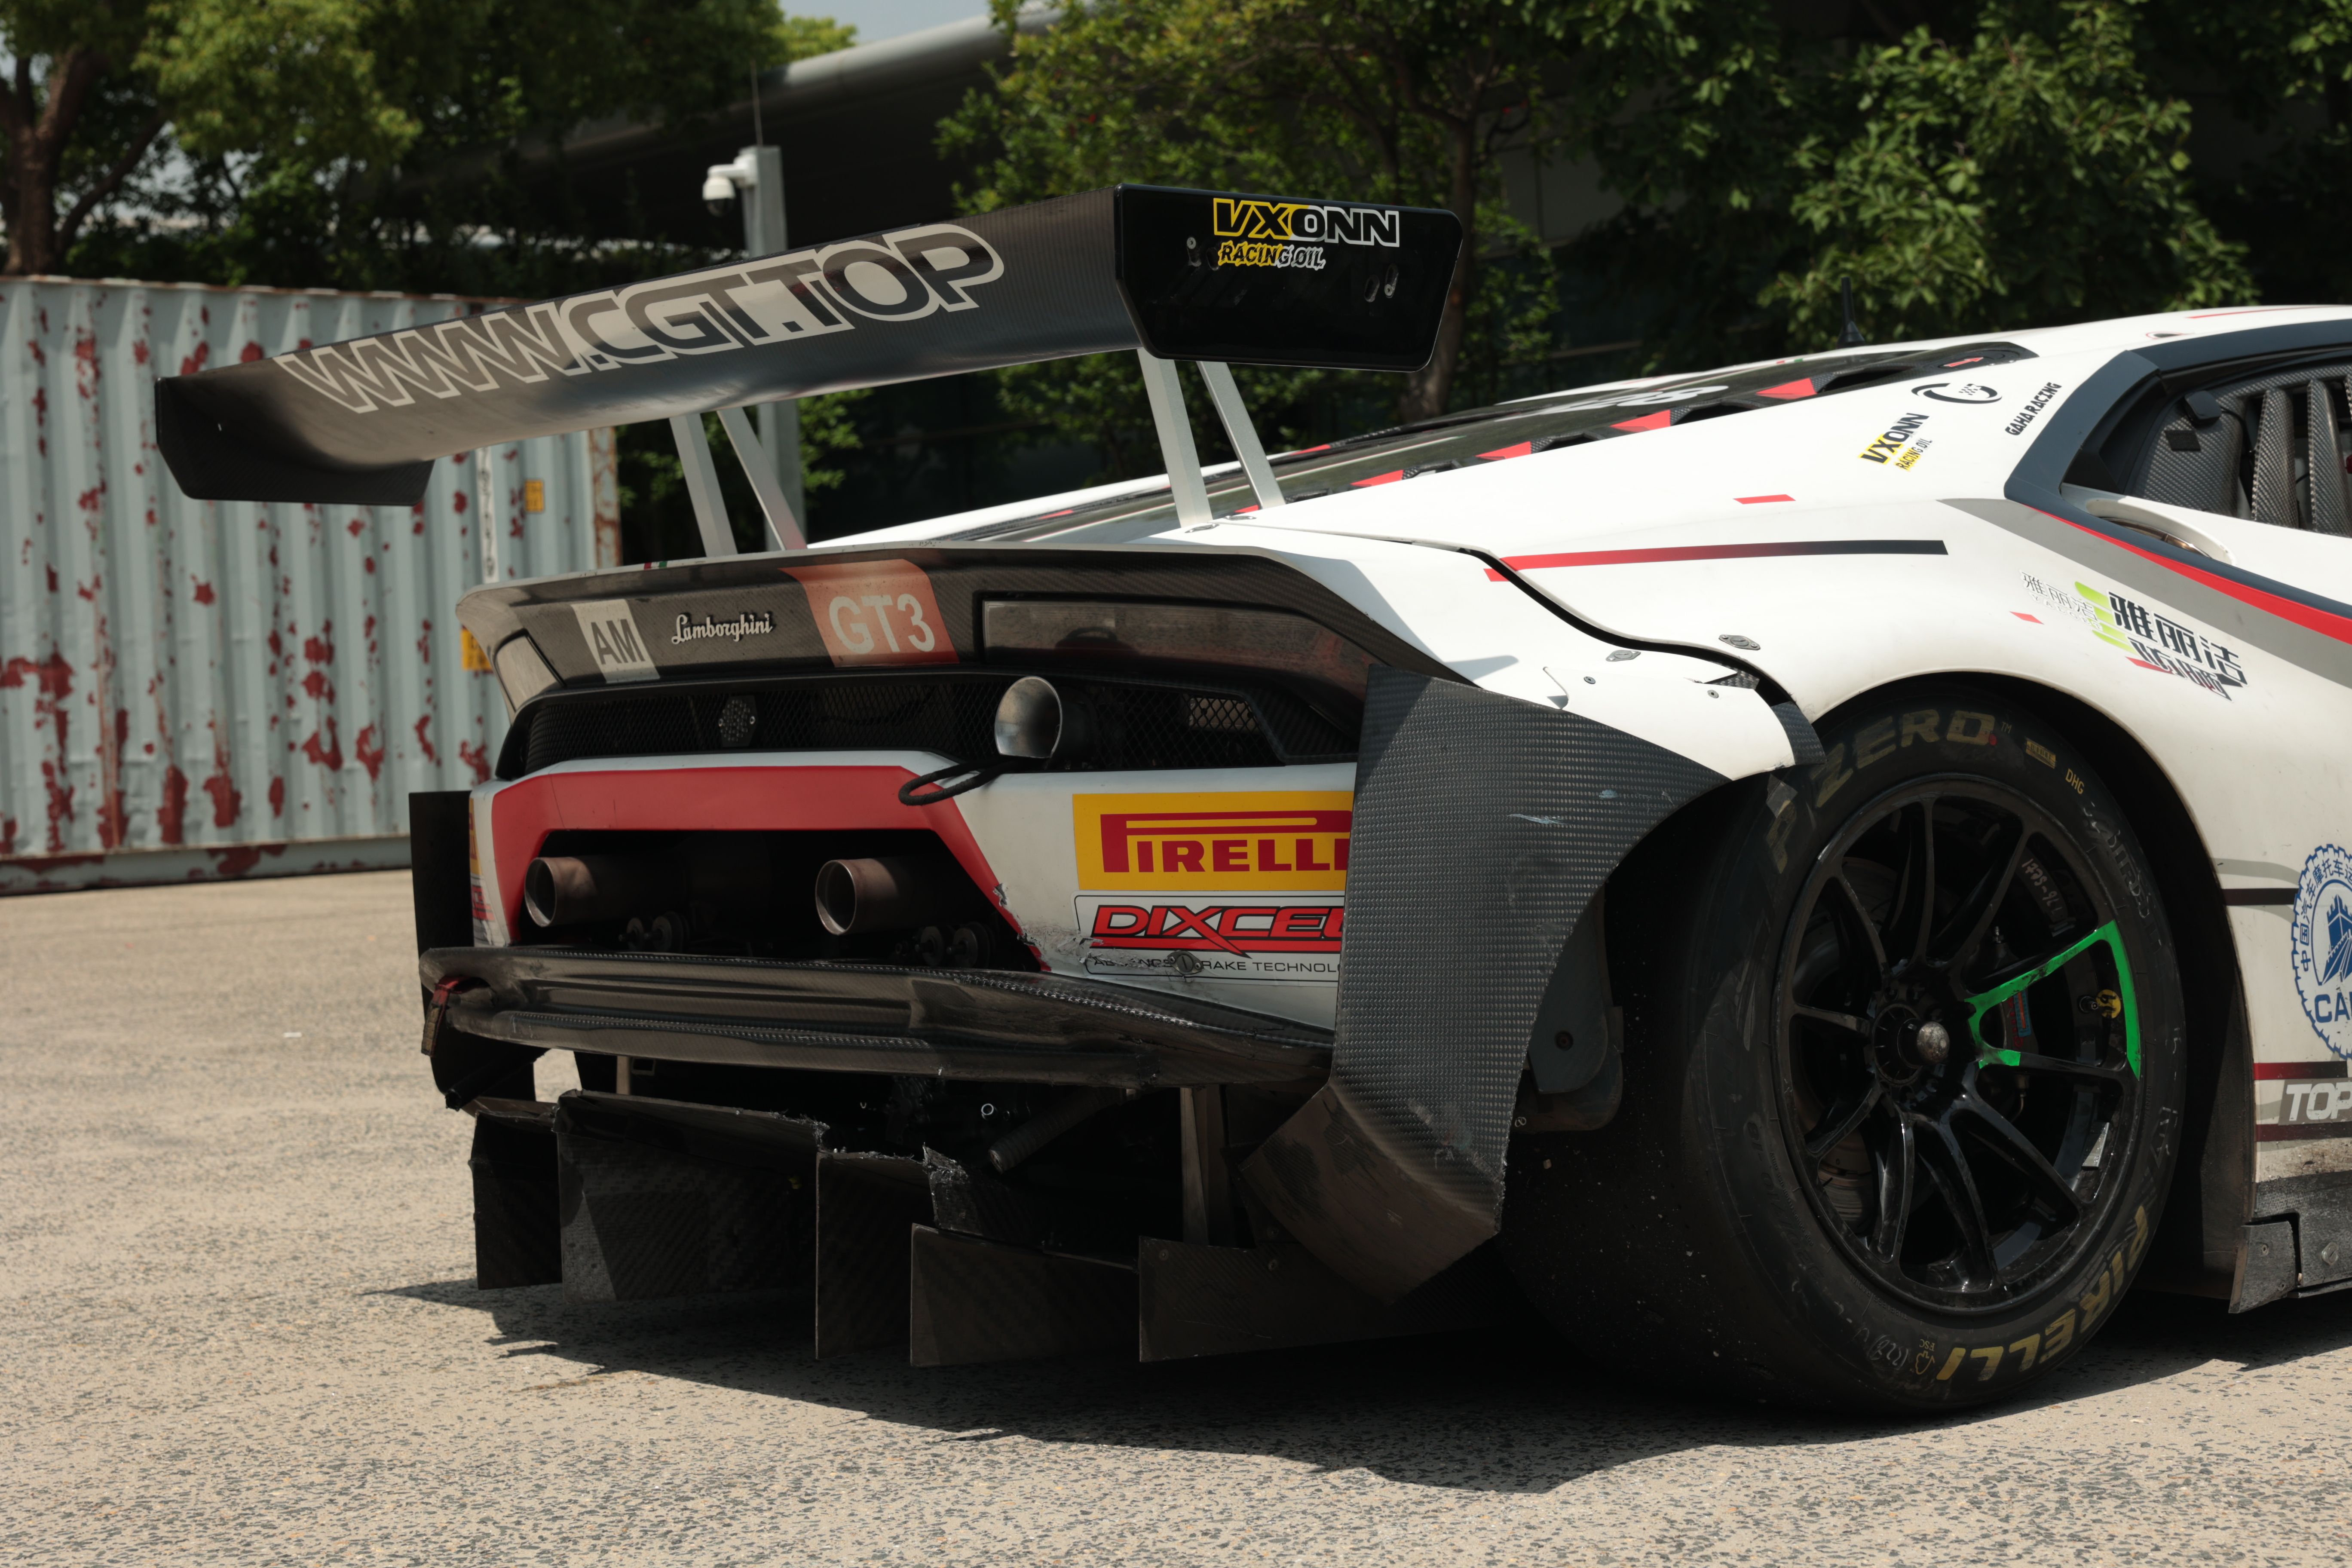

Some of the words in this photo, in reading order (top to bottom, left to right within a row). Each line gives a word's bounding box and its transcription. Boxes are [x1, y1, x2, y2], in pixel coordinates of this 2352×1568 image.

[1213, 198, 1400, 248] VXONN
[1218, 240, 1291, 268] RACING
[1291, 245, 1326, 271] OIL
[273, 224, 1005, 413] WWW.CGT.TOP
[2029, 382, 2061, 414] RACING
[1858, 413, 1930, 465] VXONN
[1895, 446, 1923, 472] RACING
[2021, 572, 2098, 621] 雅丽洁
[590, 618, 646, 665] AM
[671, 612, 773, 645] Lamborghini
[829, 593, 936, 654] GT3
[2108, 591, 2248, 685] 雅丽洁
[1809, 708, 1996, 808] ZERO
[2065, 768, 2085, 795] DHG
[1100, 810, 1353, 873] PIRELLI
[1201, 960, 1247, 971] RAKE
[1252, 962, 1340, 973] TECHNOL
[2314, 991, 2352, 1023] CA
[2286, 1081, 2352, 1121] TOP
[1936, 1205, 2149, 1381] PIRELLI
